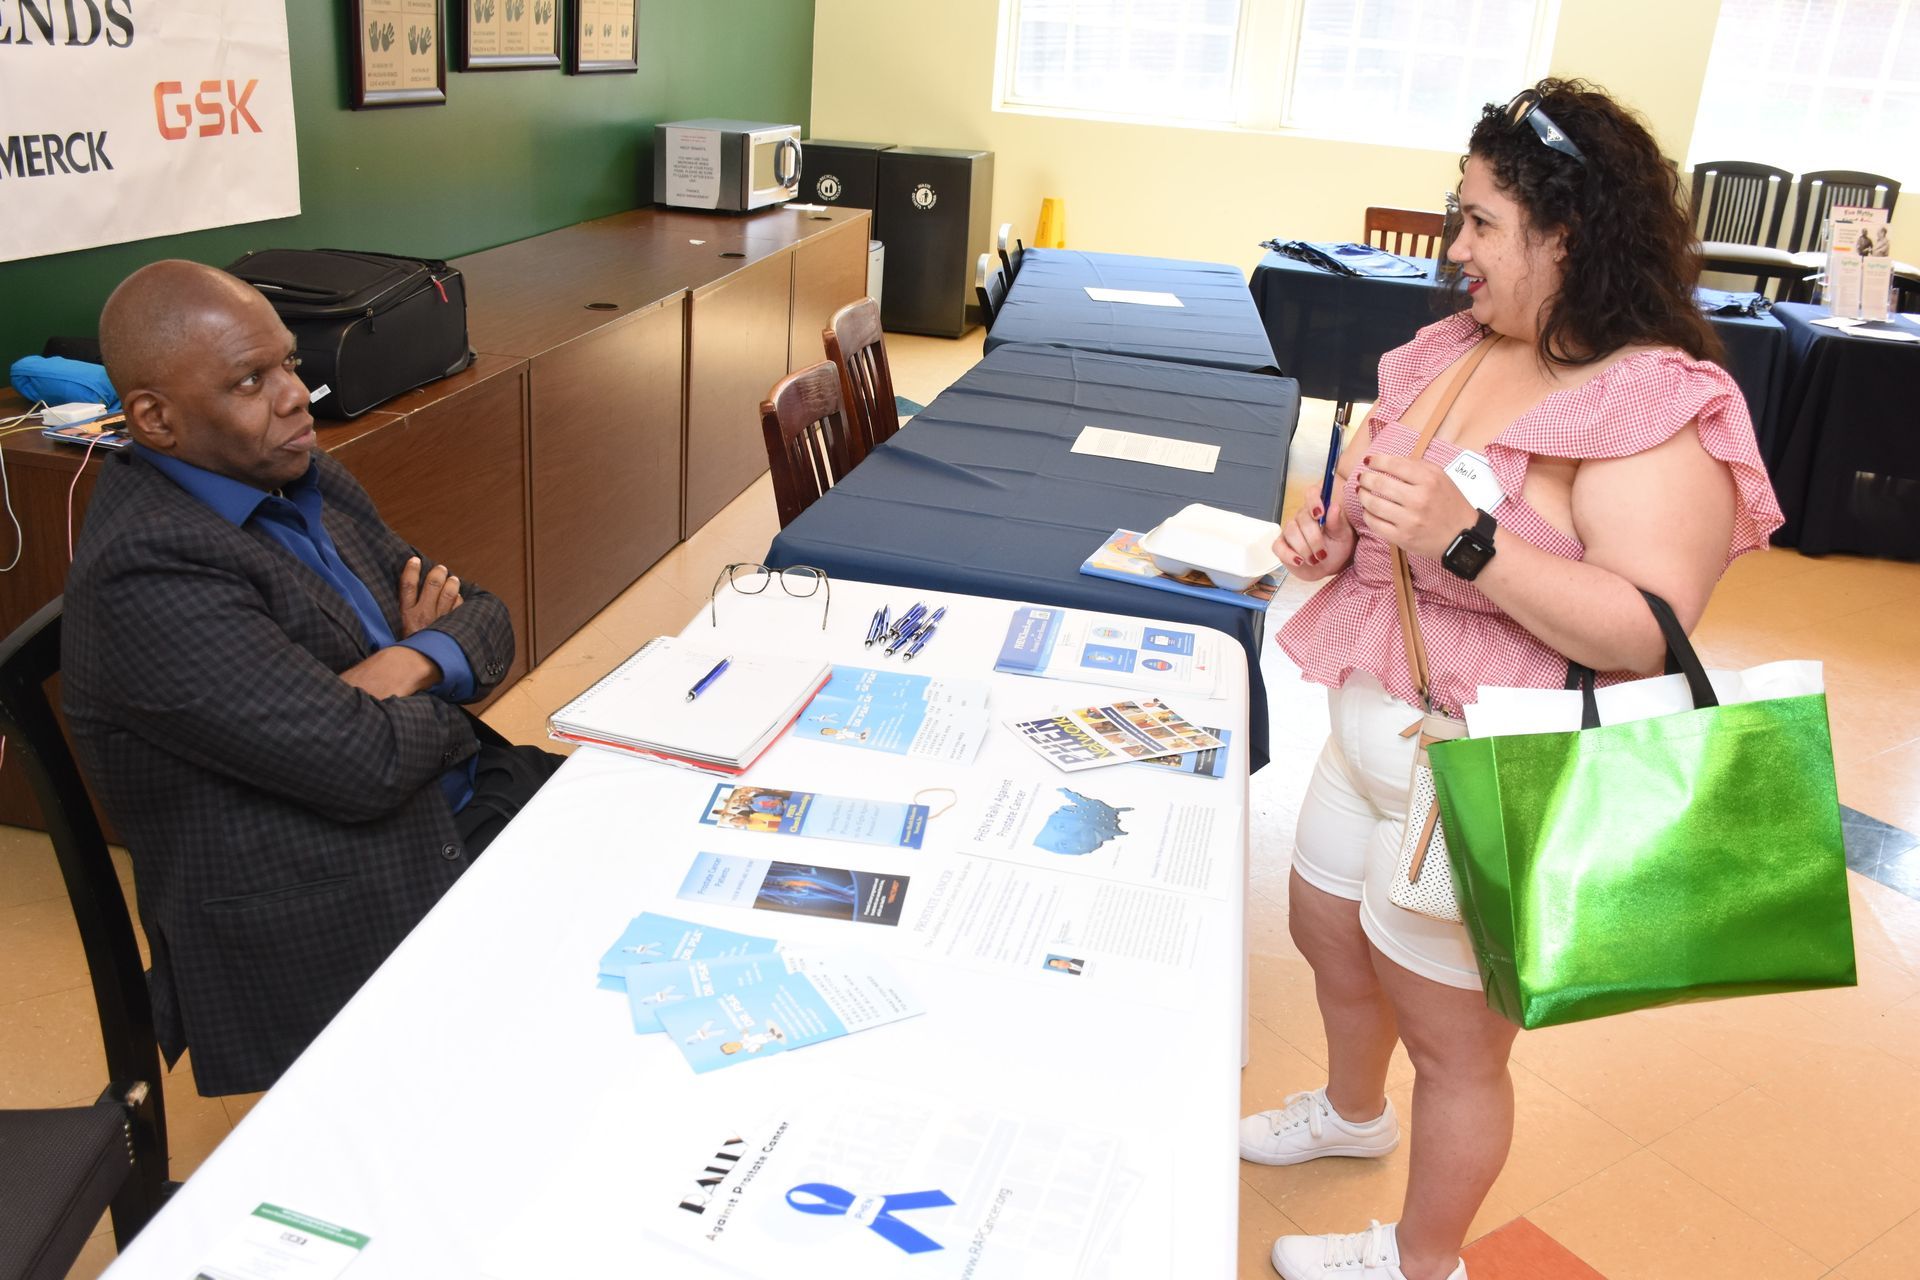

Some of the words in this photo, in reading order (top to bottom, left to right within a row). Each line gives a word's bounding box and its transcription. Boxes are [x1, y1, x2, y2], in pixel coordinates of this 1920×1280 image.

[154, 79, 263, 140] GSK
[0, 130, 114, 179] MERCK
[1015, 717, 1093, 765] PHEN
[1051, 716, 1110, 761] Network
[996, 811, 1018, 837] Prostate
[1009, 789, 1026, 811] Cancer
[705, 1197, 739, 1242] Against
[733, 1154, 768, 1194] Prostate
[762, 1121, 790, 1153] Cancer
[854, 1197, 875, 1220] PHEN
